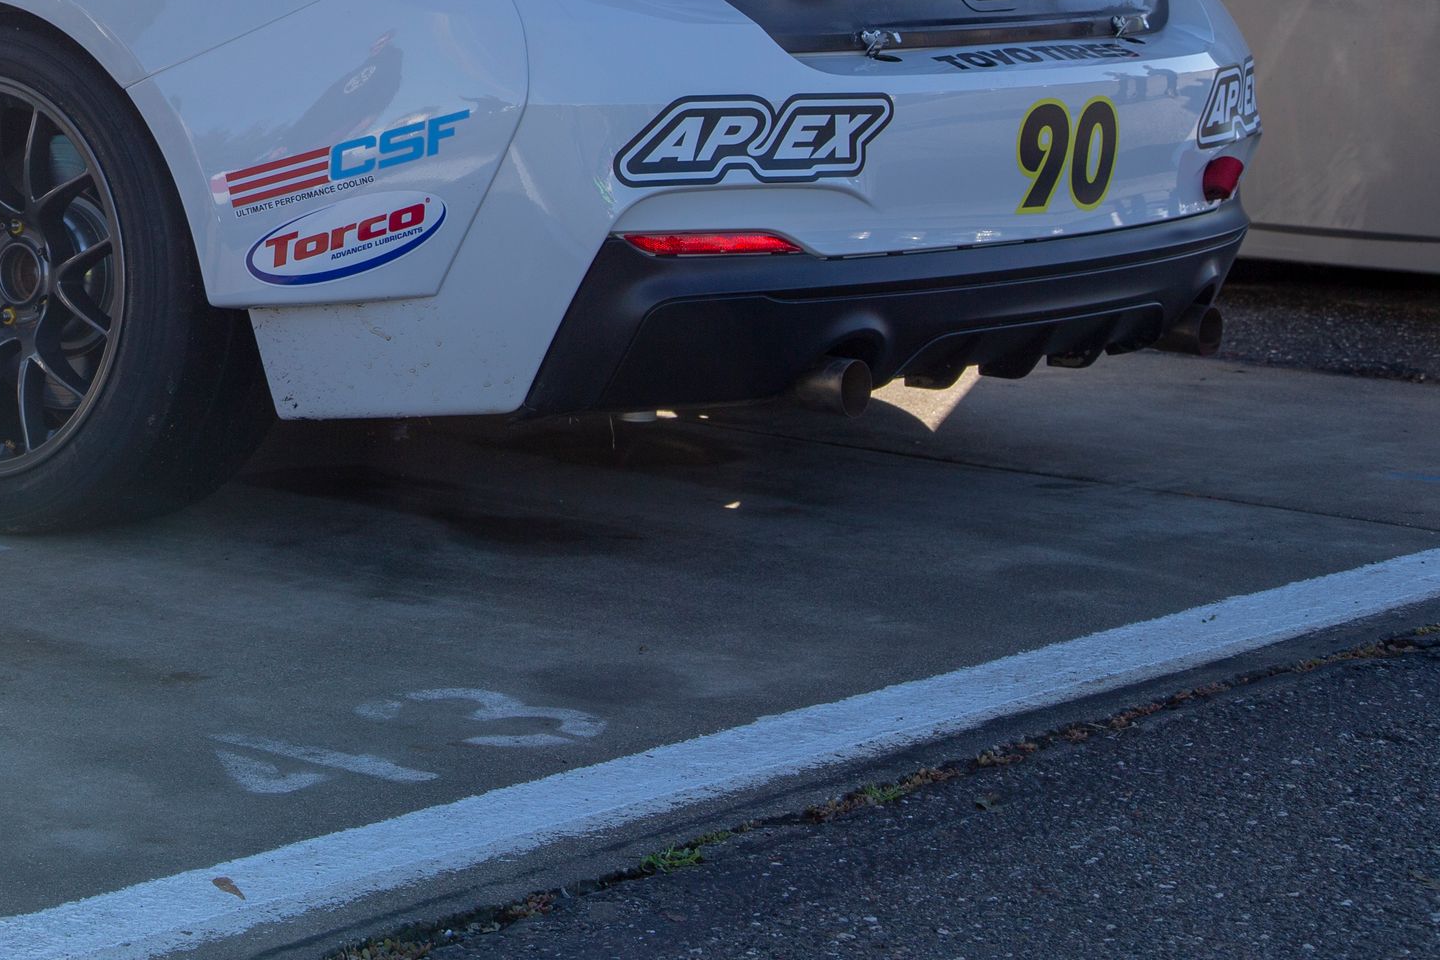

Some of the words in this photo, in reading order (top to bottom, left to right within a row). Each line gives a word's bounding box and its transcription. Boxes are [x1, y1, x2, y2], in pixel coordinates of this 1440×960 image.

[329, 108, 471, 182] CSF
[636, 108, 878, 168] APEX
[1015, 96, 1119, 214] 90
[235, 199, 275, 218] ULTIMATE
[275, 185, 336, 208] PERFORMANCE
[336, 175, 375, 192] COOLING
[331, 242, 373, 260] ADVANCED
[374, 226, 423, 247] LUBRICANTS
